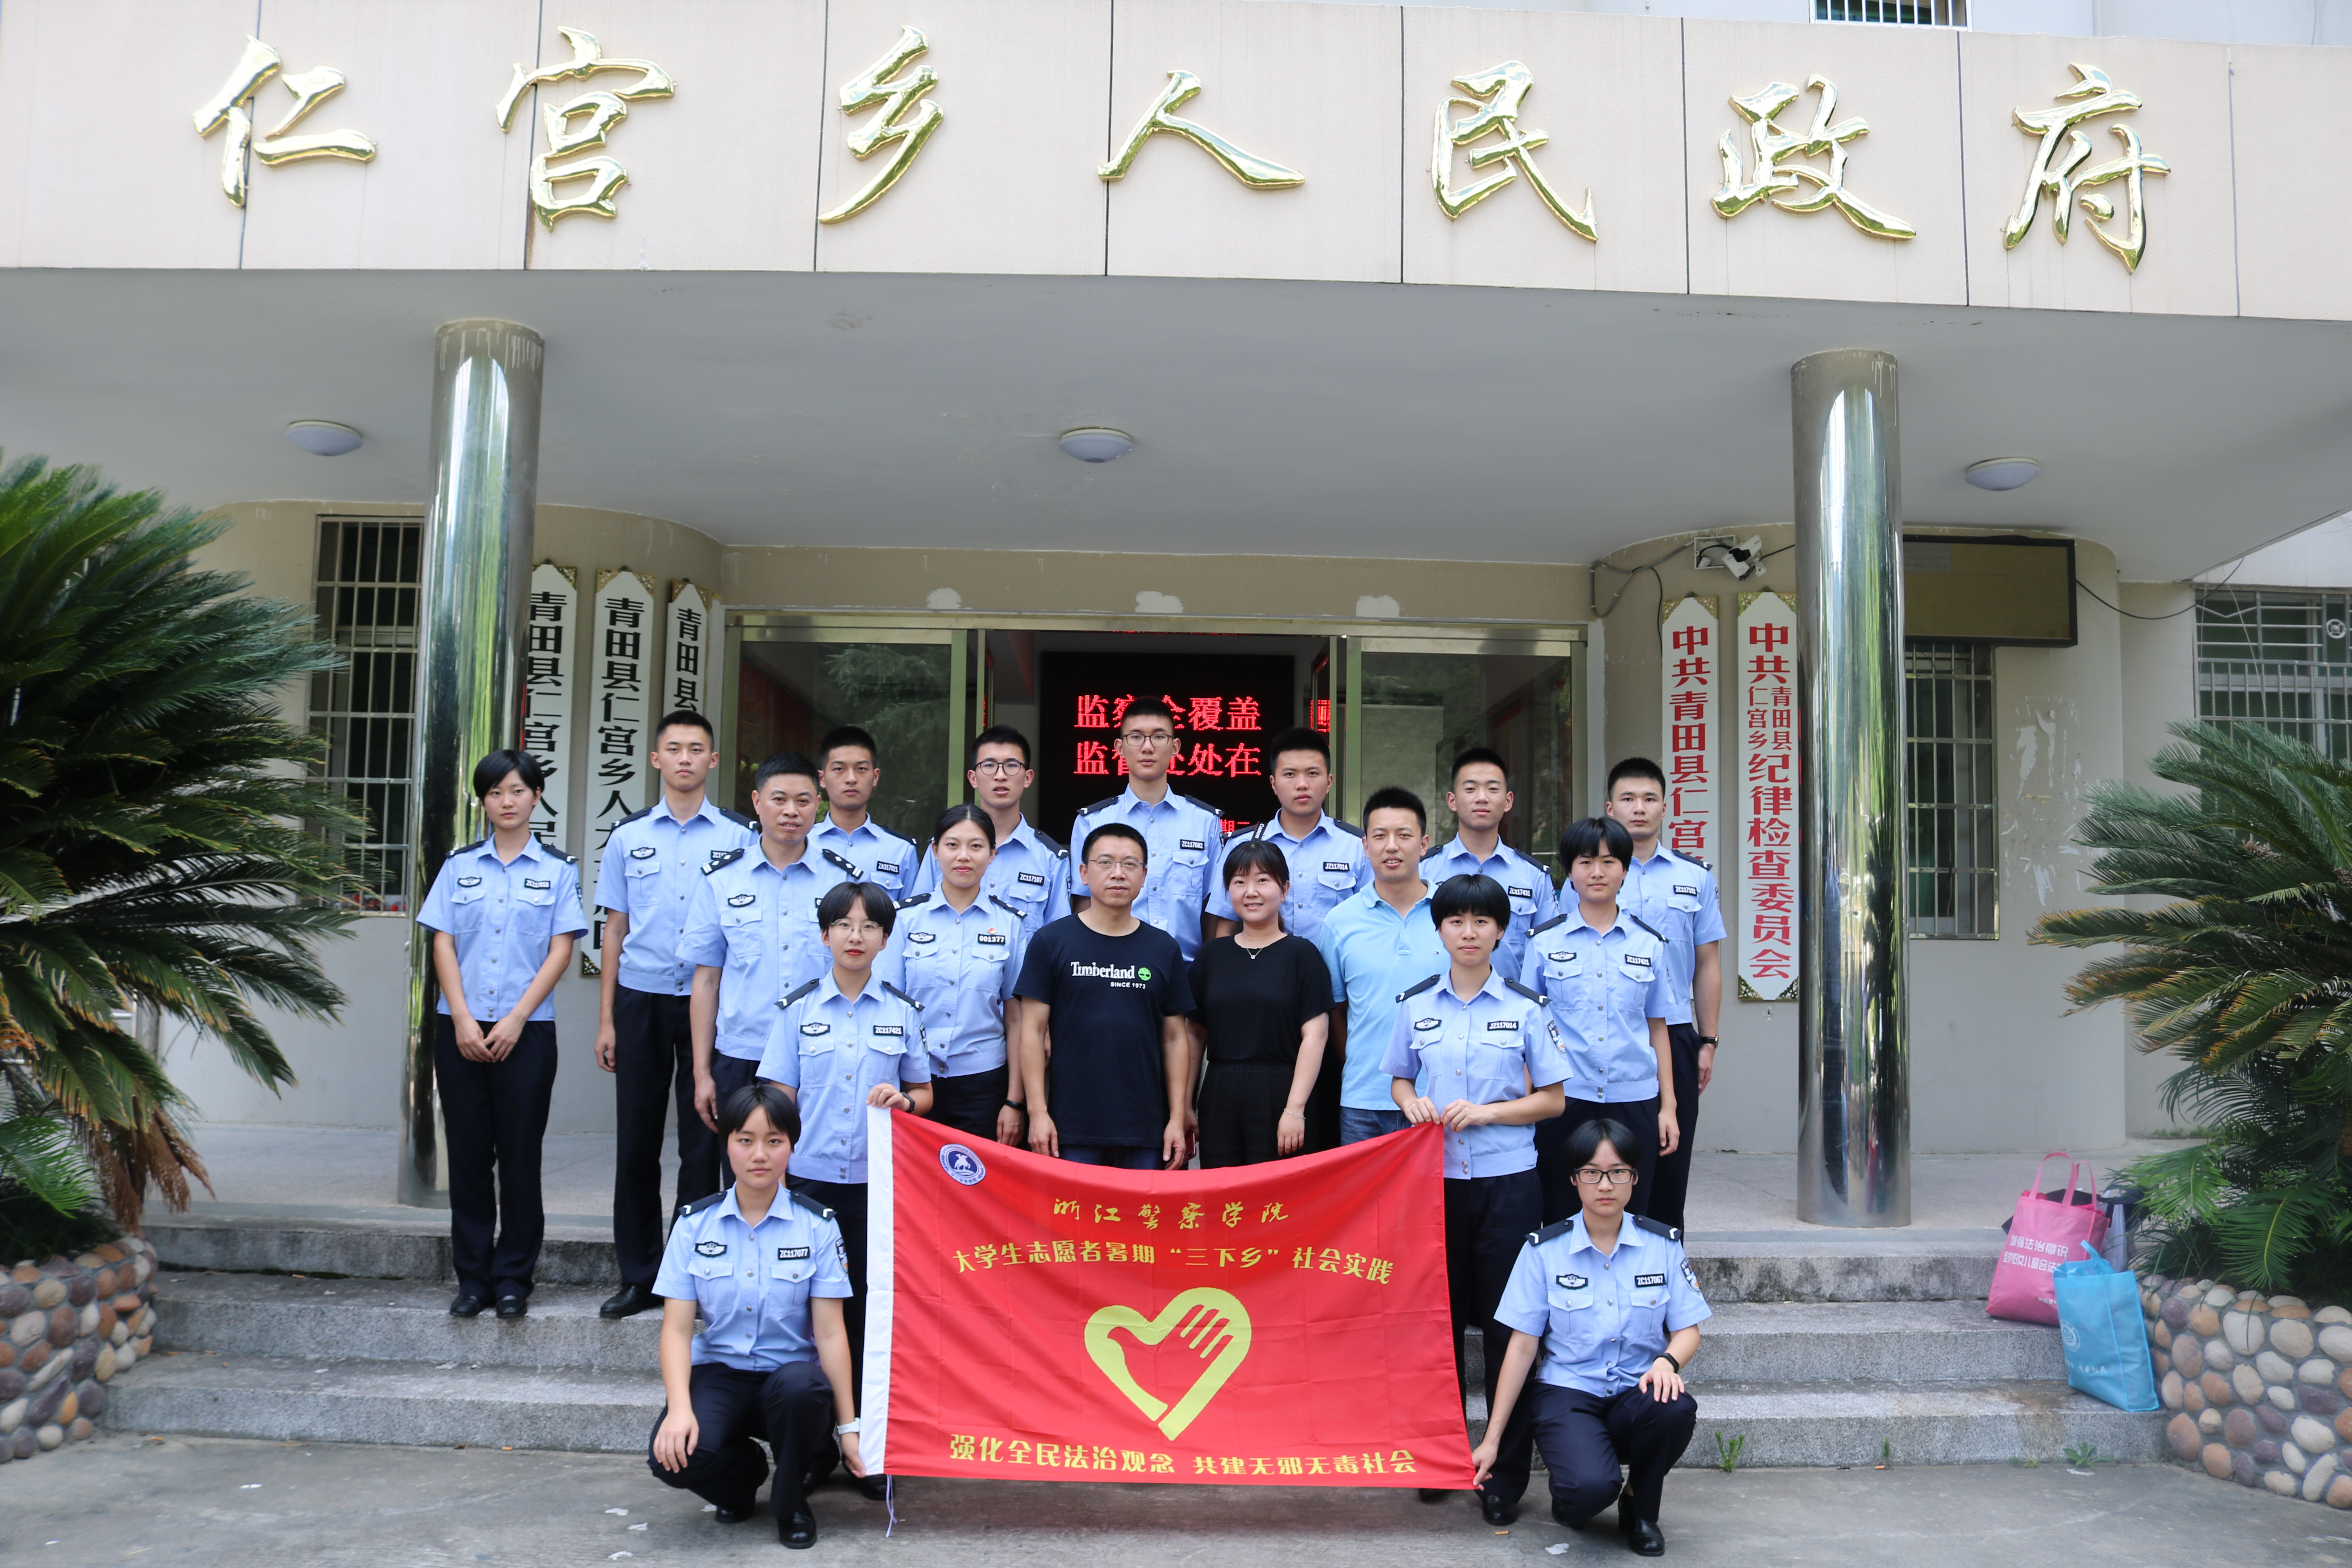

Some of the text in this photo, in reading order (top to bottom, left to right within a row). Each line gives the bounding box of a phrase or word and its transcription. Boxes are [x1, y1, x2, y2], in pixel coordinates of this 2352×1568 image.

[192, 25, 2172, 274] 仁宫乡人民政府
[673, 608, 702, 712] 青田县
[1747, 686, 1769, 751] 仁宫乡
[1771, 686, 1793, 751] 青田县
[1669, 626, 1711, 860] 中共青田县仁宫
[593, 598, 645, 949] 青田县仁宫乡人
[1254, 823, 1265, 839] Canon
[1181, 840, 1203, 849] ZC117082
[878, 862, 898, 873] ZA317021
[1747, 753, 1795, 979] 纪律检查委员会
[1019, 873, 1043, 884] ZC117107
[1509, 887, 1531, 897] ZC117431
[1070, 961, 1136, 979] Timberland
[1626, 956, 1650, 965] ZC117421
[1053, 1198, 1289, 1230] 浙江警察学院
[779, 1248, 809, 1258] ZC117077
[2009, 1235, 2069, 1258] 增强法治意识
[2002, 1251, 2062, 1273] 维护妇女儿童合法
[1636, 1275, 1664, 1286] ZC117067
[949, 1434, 1417, 1475] 强化全民法治观念 共建无邪无毒社会
